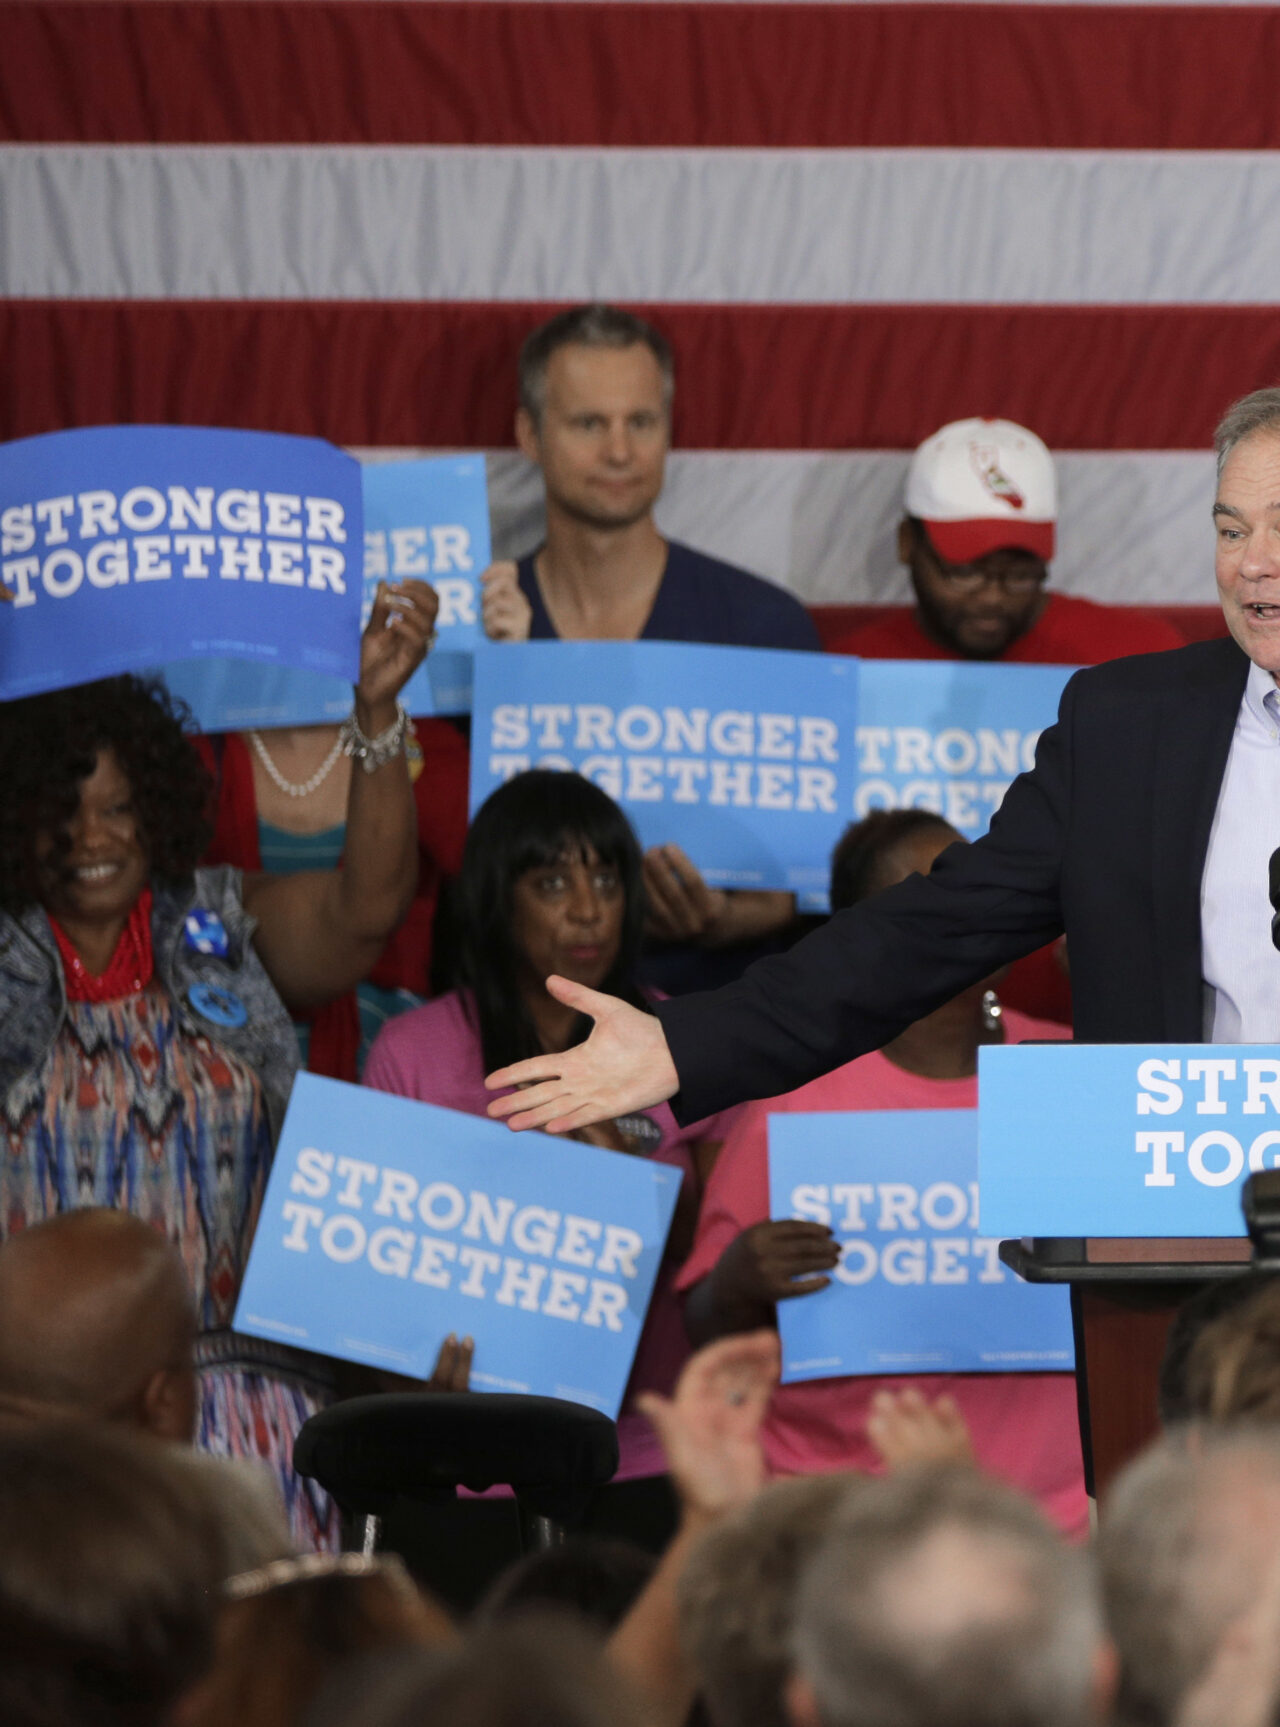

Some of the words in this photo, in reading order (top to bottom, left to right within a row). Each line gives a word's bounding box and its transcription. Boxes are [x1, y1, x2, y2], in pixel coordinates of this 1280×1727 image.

[1, 486, 347, 555] STRONGER
[3, 535, 346, 608] TOGETHER
[491, 704, 839, 762] STRONGER
[489, 753, 838, 813] TGETHER
[289, 1147, 643, 1279] STRONGER
[790, 1181, 979, 1231] STRO
[281, 1201, 629, 1332] TOGETHER
